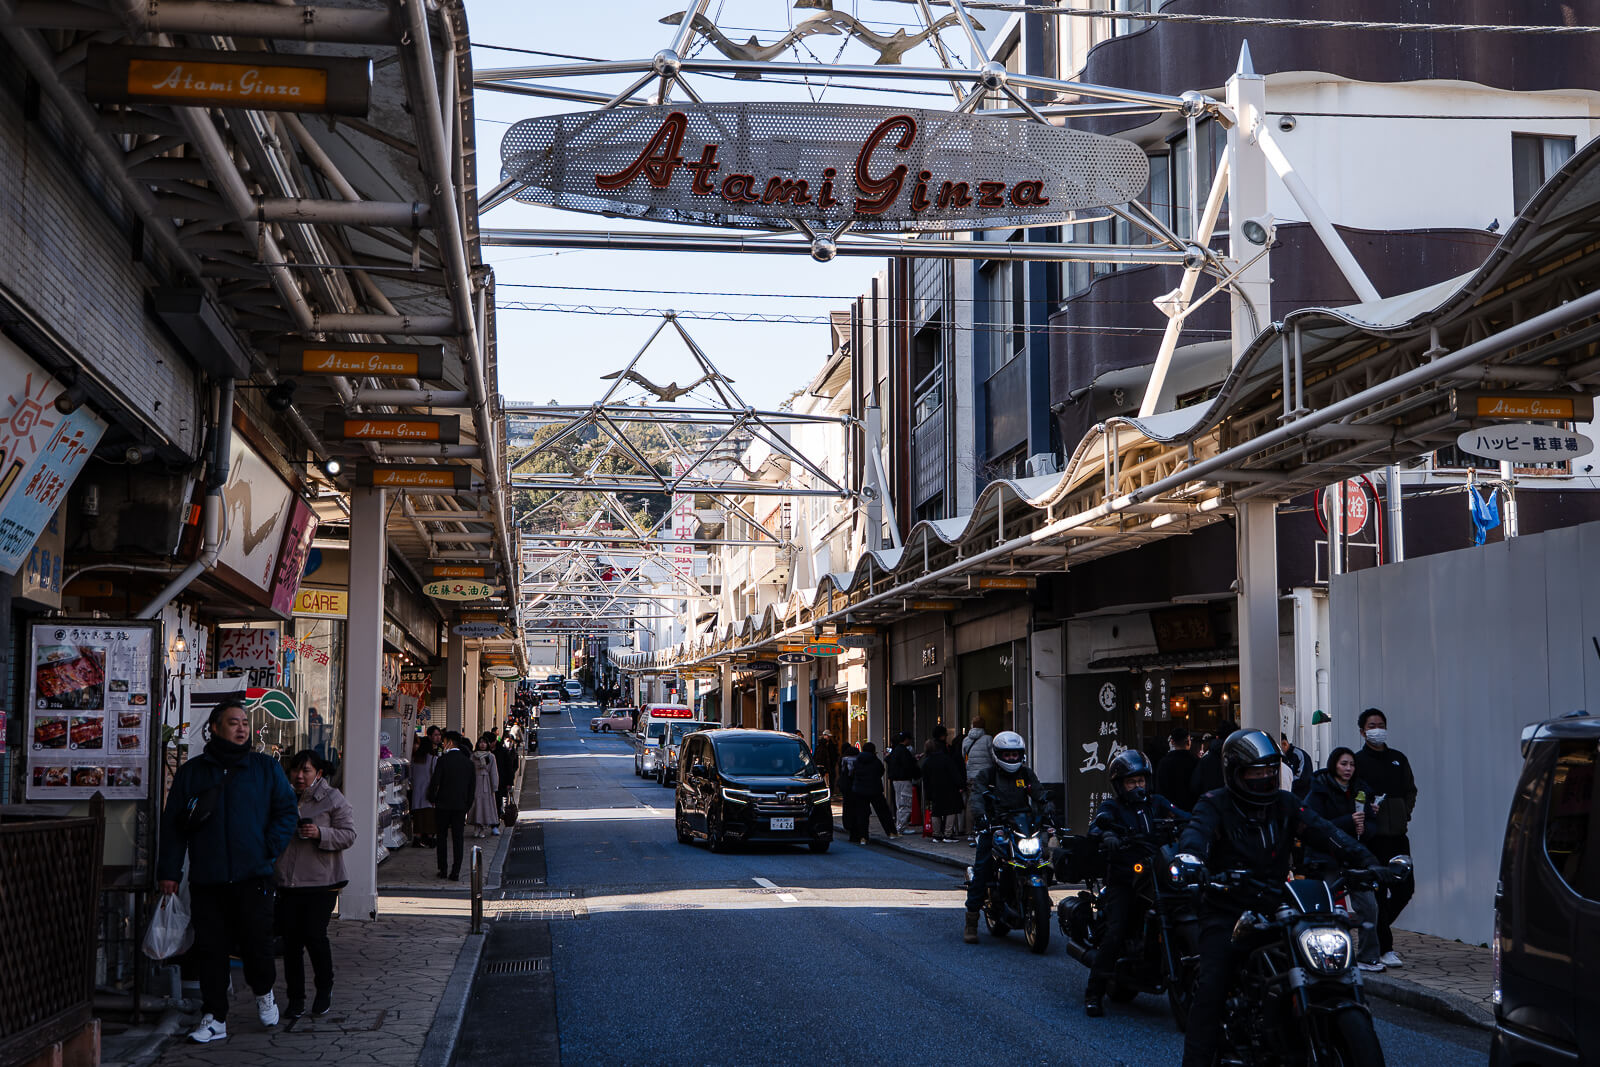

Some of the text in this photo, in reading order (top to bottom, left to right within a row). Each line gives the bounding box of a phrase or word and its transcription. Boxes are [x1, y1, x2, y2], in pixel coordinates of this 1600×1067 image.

[153, 66, 300, 96] Atami Ginza
[596, 111, 1050, 215] Atami Ginza
[318, 354, 404, 371] Atami Ginza
[1489, 400, 1561, 415] Atami Ginza
[356, 423, 427, 437] Atami Ginza
[46, 420, 88, 465] パーティー
[1476, 436, 1579, 452] ハッピー駐車場
[381, 472, 444, 484] Atami Ginza
[302, 594, 339, 611] CARE
[233, 629, 269, 645] ナイト
[222, 643, 274, 660] スポット
